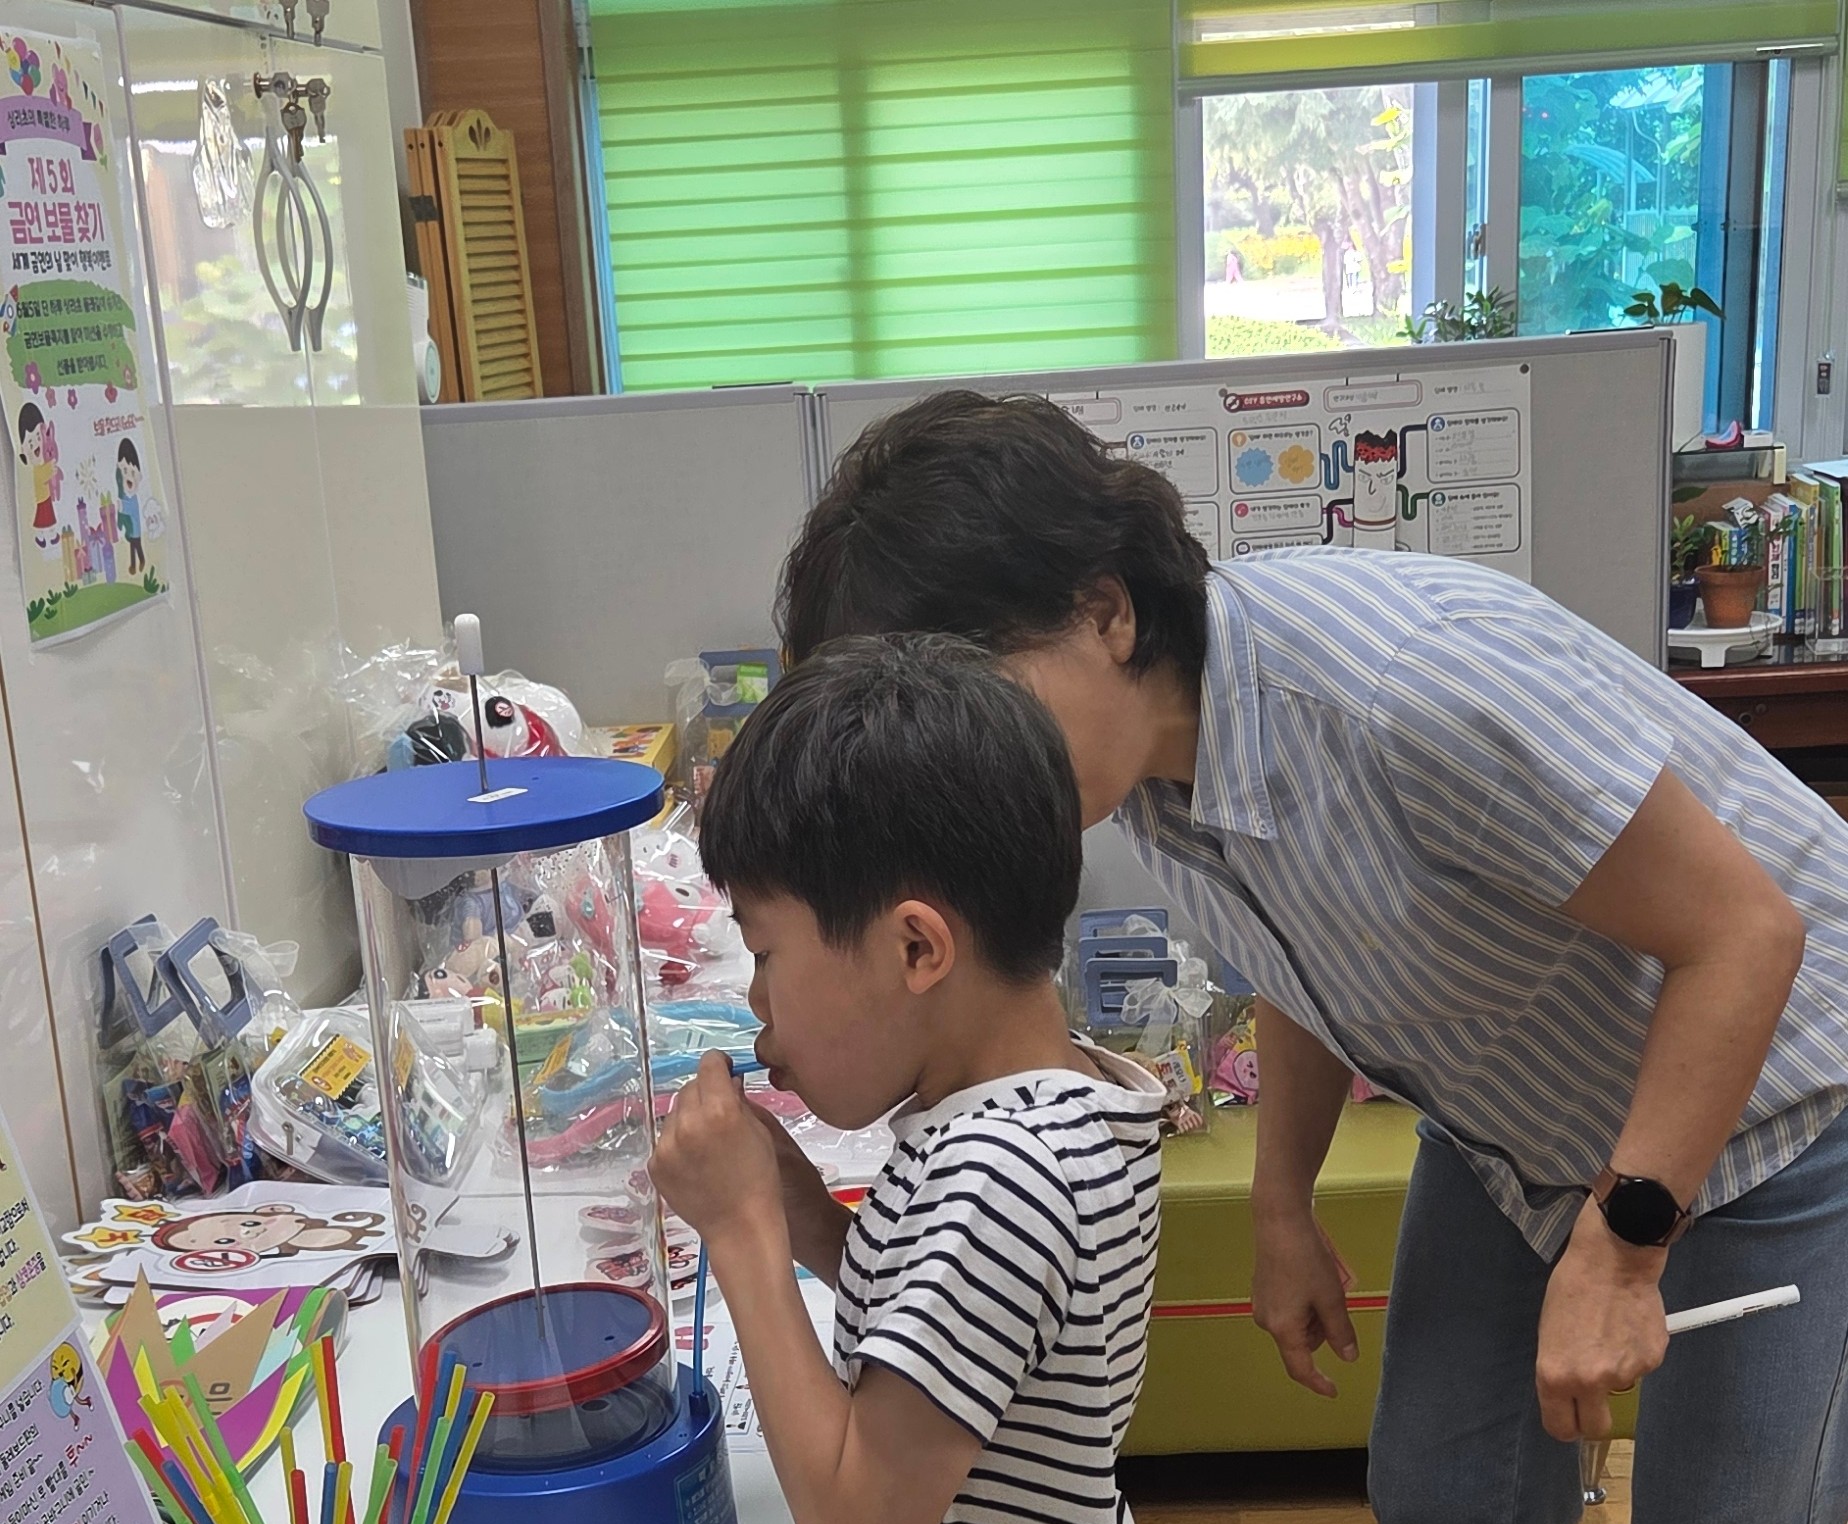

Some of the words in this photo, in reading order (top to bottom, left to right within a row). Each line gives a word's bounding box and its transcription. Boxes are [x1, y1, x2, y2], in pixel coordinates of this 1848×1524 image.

[28, 157, 75, 195] 제5회
[8, 201, 44, 244] 금연
[43, 202, 76, 243] 보물
[74, 200, 105, 242] 찾기
[12, 1467, 27, 1488] 준비
[38, 1485, 46, 1499] 후
[45, 1461, 68, 1493] 빨대를
